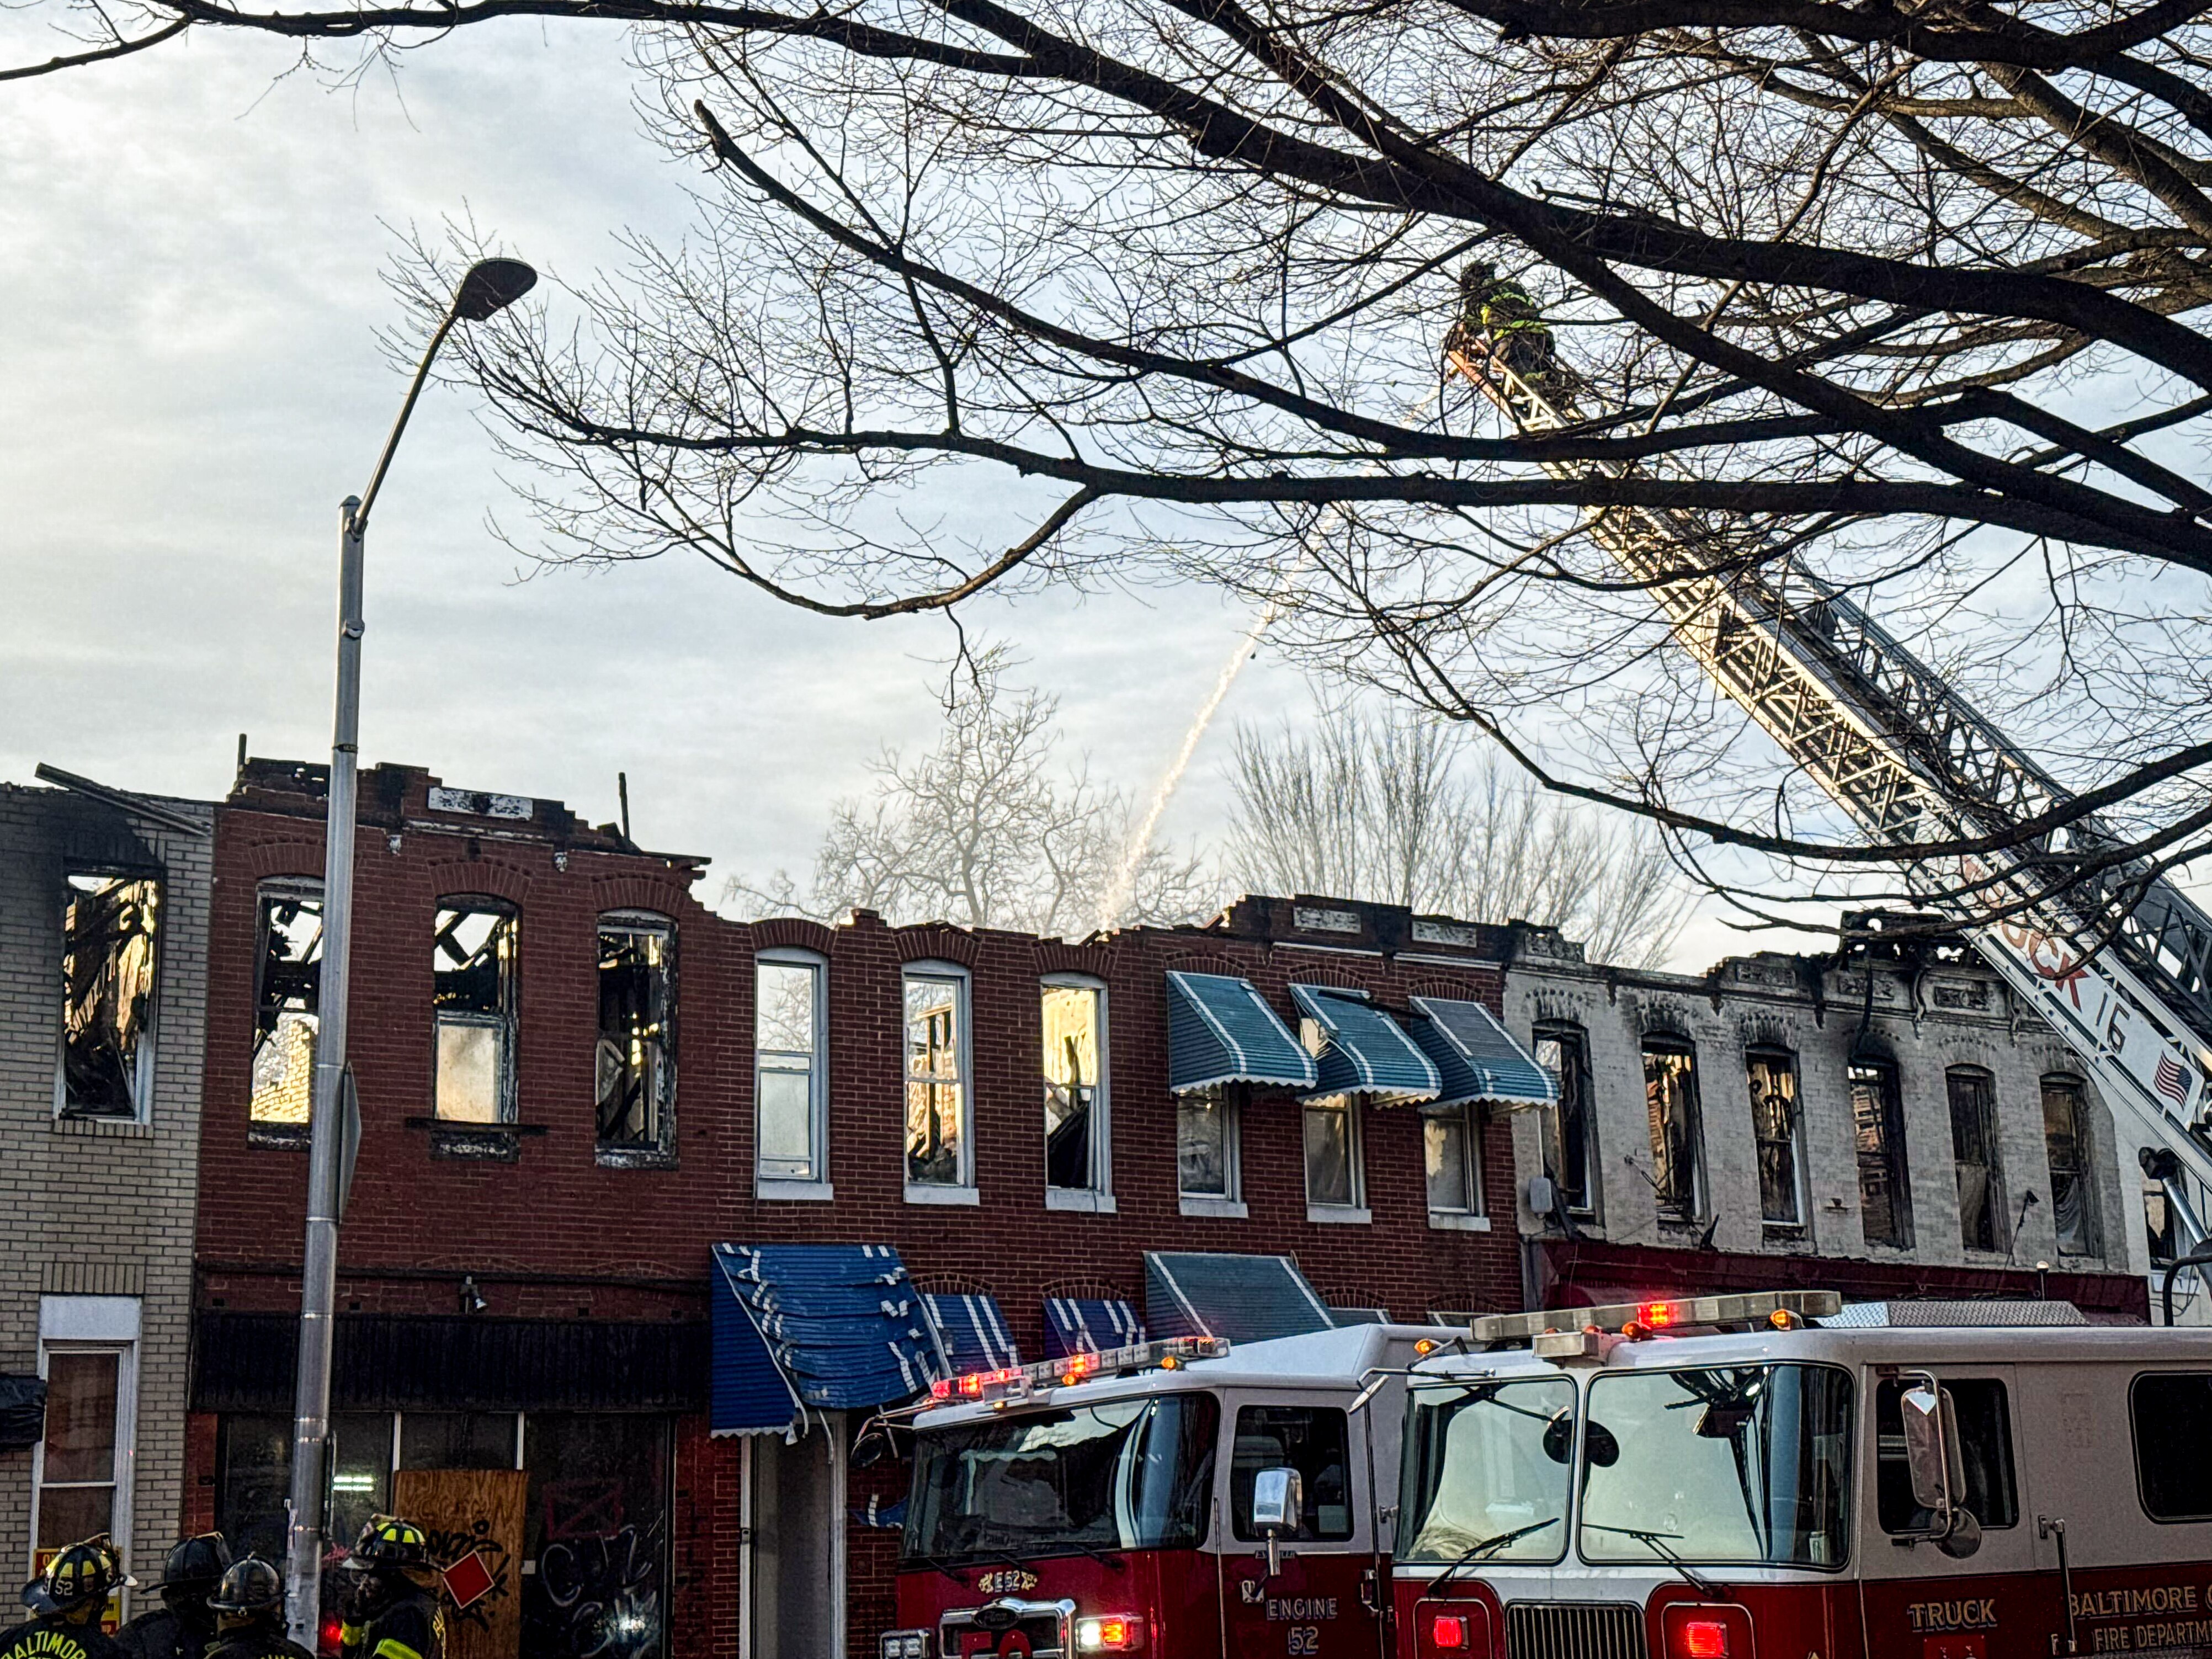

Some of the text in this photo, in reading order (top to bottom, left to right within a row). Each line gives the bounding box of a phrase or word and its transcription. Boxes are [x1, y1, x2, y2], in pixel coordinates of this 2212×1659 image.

[2095, 992, 2130, 1055] 16
[55, 1580, 74, 1596] 52
[995, 1570, 1020, 1592] E 52
[1266, 1598, 1338, 1620] ENGINE
[1907, 1599, 1997, 1631] TRUCK
[2069, 1586, 2198, 1619] BALTIMORE
[1288, 1626, 1319, 1655] 52
[2092, 1620, 2212, 1652] FIRE DEPARTM
